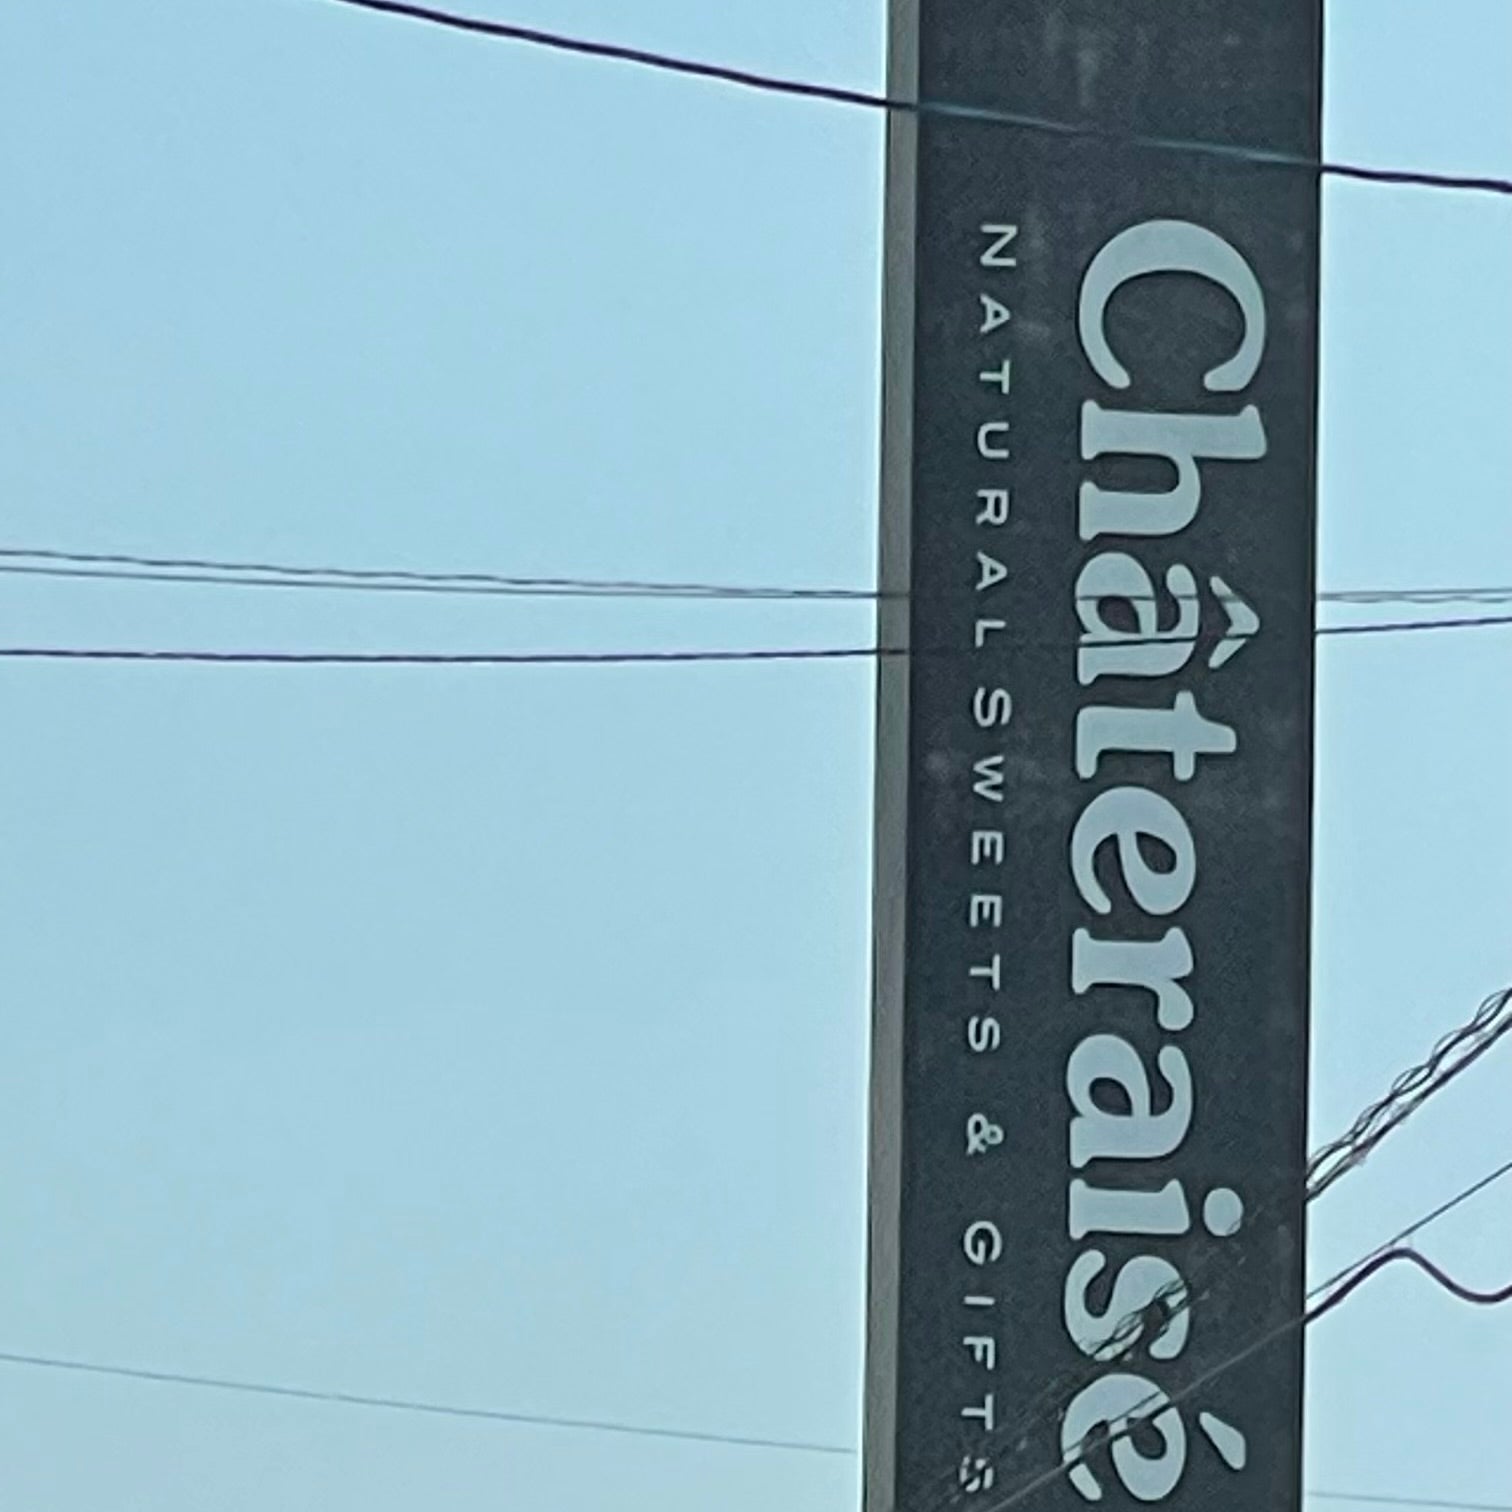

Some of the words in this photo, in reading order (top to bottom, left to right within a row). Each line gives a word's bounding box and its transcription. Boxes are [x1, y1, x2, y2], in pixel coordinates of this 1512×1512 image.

[974, 223, 1018, 647] NATURAL
[967, 686, 1012, 1052] SWEETS
[1061, 219, 1268, 1501] Châteraisé
[965, 1113, 1004, 1155] &
[960, 1220, 1003, 1493] GIFTS
